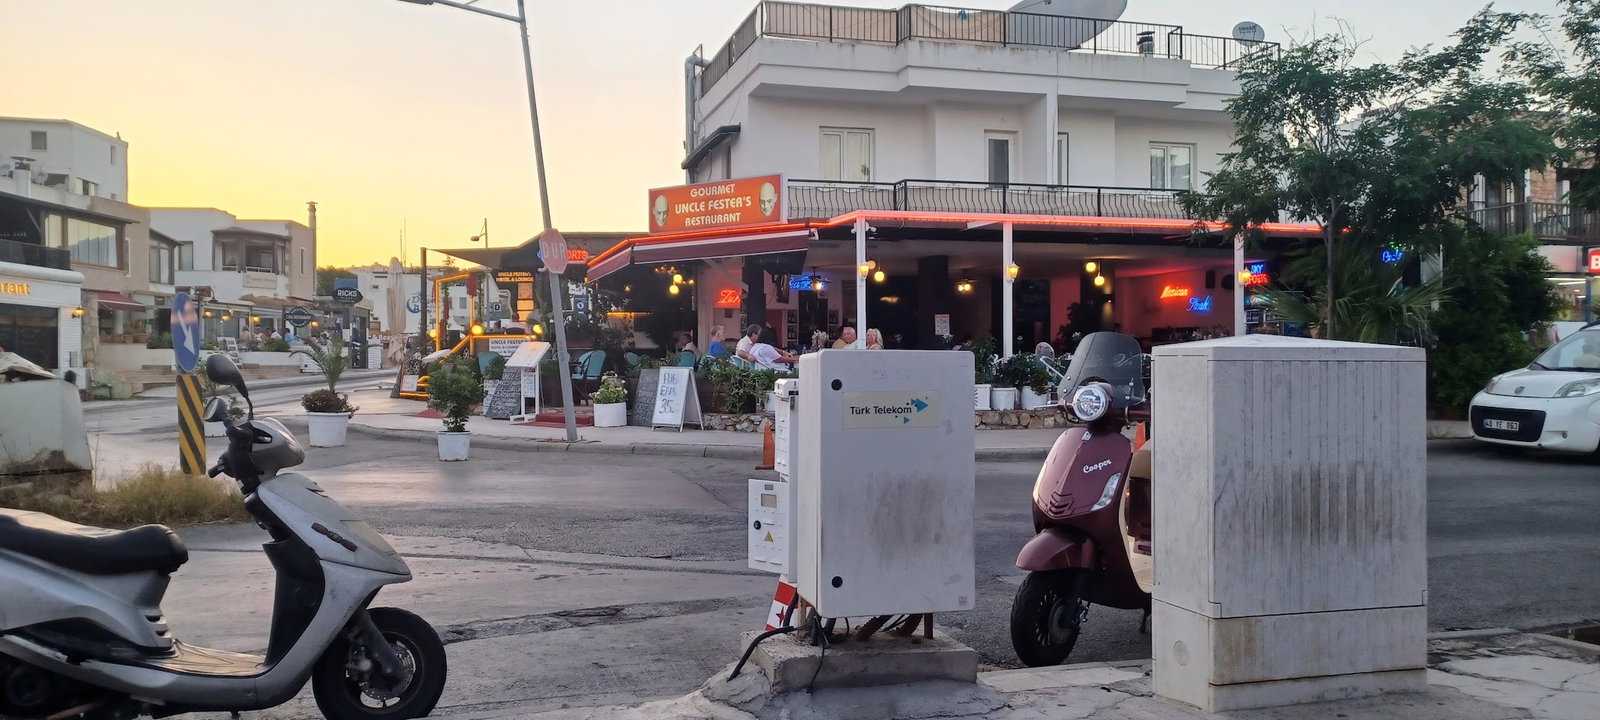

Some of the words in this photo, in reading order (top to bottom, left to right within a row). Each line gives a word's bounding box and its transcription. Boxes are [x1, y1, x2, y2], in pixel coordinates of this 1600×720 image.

[690, 183, 736, 198] GOURMET
[675, 200, 706, 215] UNCLE
[708, 195, 752, 212] FESTER'S
[685, 212, 741, 227] RESTAURANT
[542, 241, 566, 261] DUR
[1250, 264, 1264, 274] SKY
[1247, 273, 1268, 284] PORTS
[337, 289, 358, 297] RICKS
[850, 405, 871, 415] Türk
[873, 404, 912, 415] Telekom
[1083, 459, 1112, 473] Cooper
